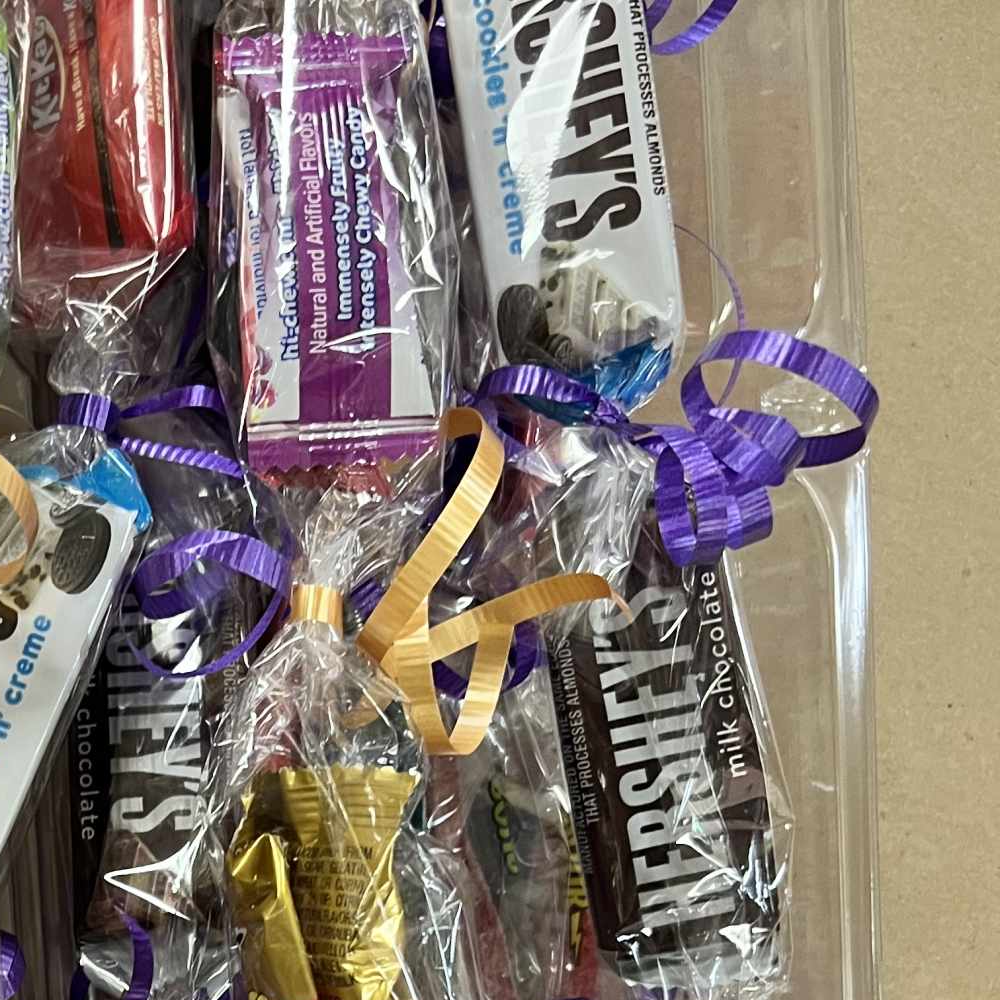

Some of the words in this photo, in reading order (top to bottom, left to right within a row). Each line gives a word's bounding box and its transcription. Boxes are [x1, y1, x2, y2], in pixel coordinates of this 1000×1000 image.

[296, 110, 318, 172] Flavors
[345, 105, 368, 170] Candy
[632, 32, 657, 119] PROCESSES
[645, 123, 666, 196] ALMONDS
[302, 173, 324, 242] Artificial
[352, 172, 375, 245] Chewy
[307, 249, 326, 283] and
[334, 200, 355, 321] Immensely
[306, 287, 330, 354] Natural
[5, 612, 53, 707] creme
[558, 639, 587, 708] ALMONDS
[699, 570, 737, 711] chocolate
[76, 707, 96, 842] chocolate
[569, 709, 598, 794] PROCESSES
[590, 586, 738, 930] HERSHEY'S
[717, 718, 748, 778] milk
[584, 794, 602, 825] THAT
